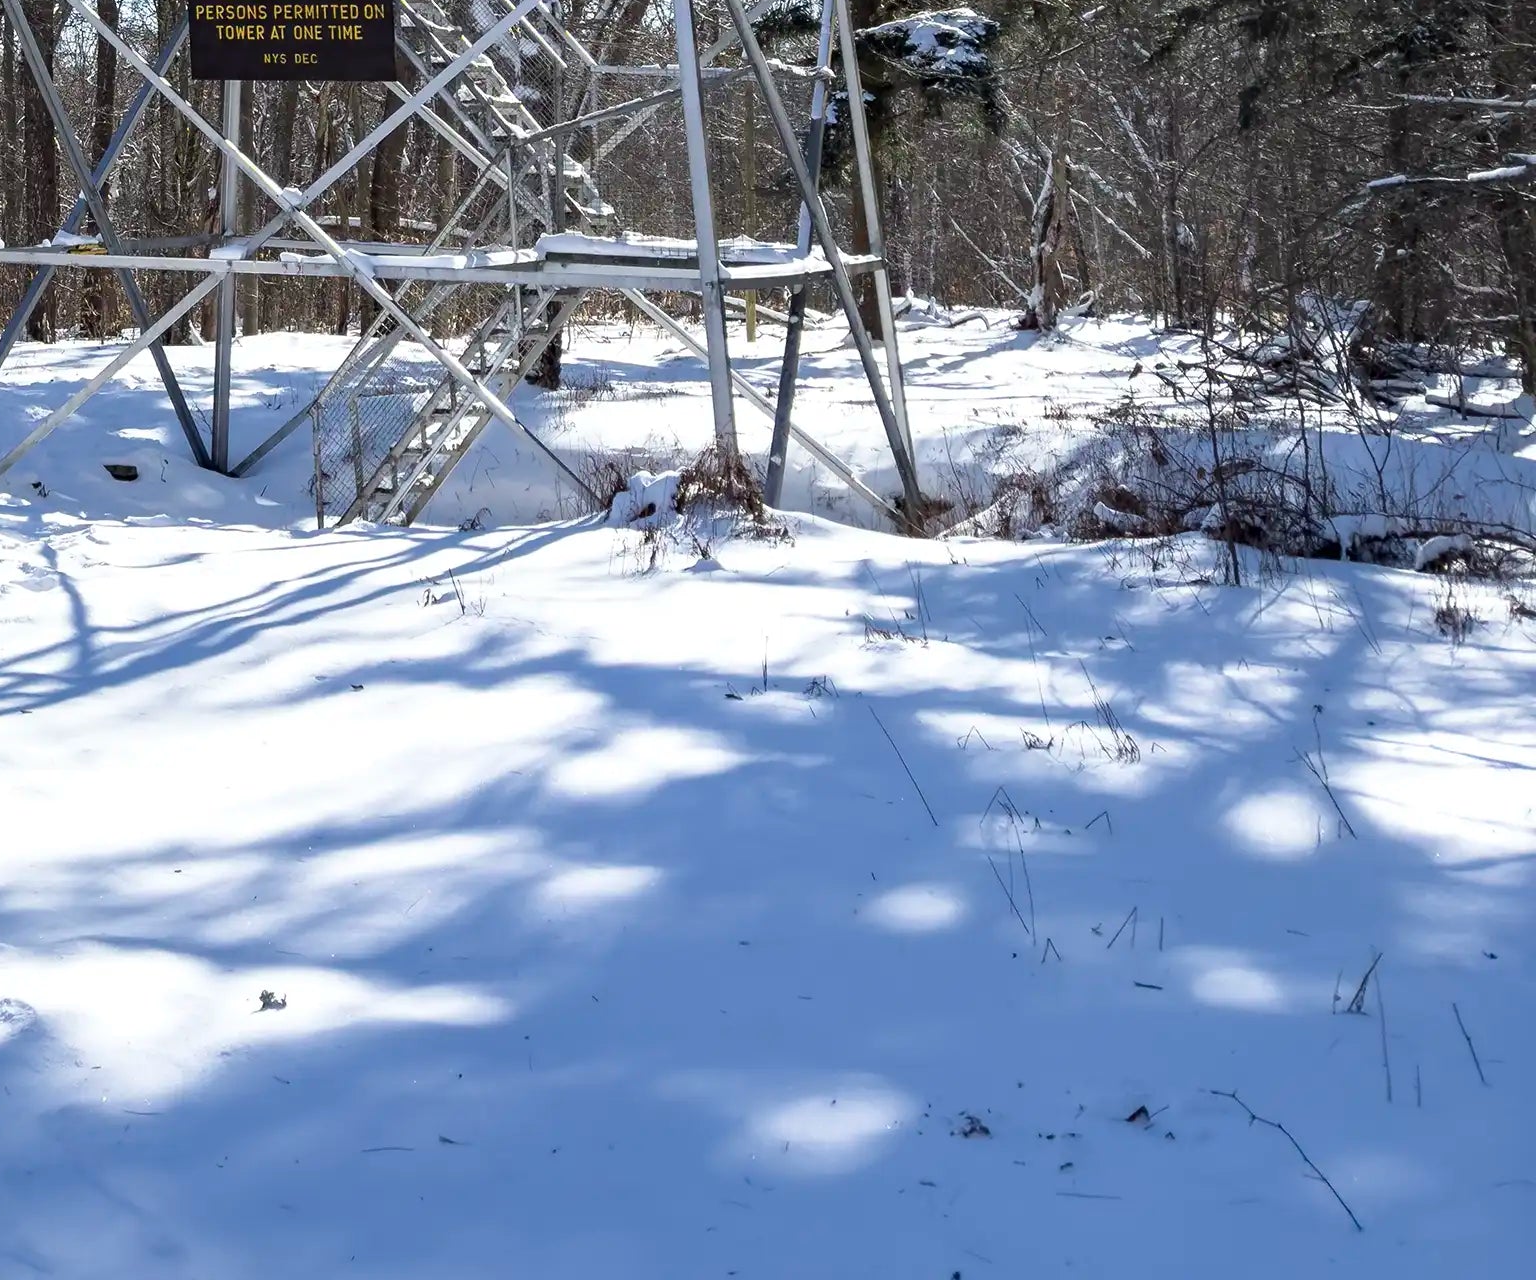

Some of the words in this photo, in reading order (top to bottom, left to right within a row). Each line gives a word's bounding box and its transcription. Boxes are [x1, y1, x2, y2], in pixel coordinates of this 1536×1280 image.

[195, 4, 268, 20] PERSONS
[273, 3, 359, 20] PERMITTED
[363, 3, 385, 20] ON
[215, 24, 265, 41] TOWER
[270, 24, 287, 40] AT
[293, 24, 323, 41] ONE
[327, 24, 364, 41] TIME
[263, 53, 287, 65] NYS
[294, 53, 318, 64] DEC
